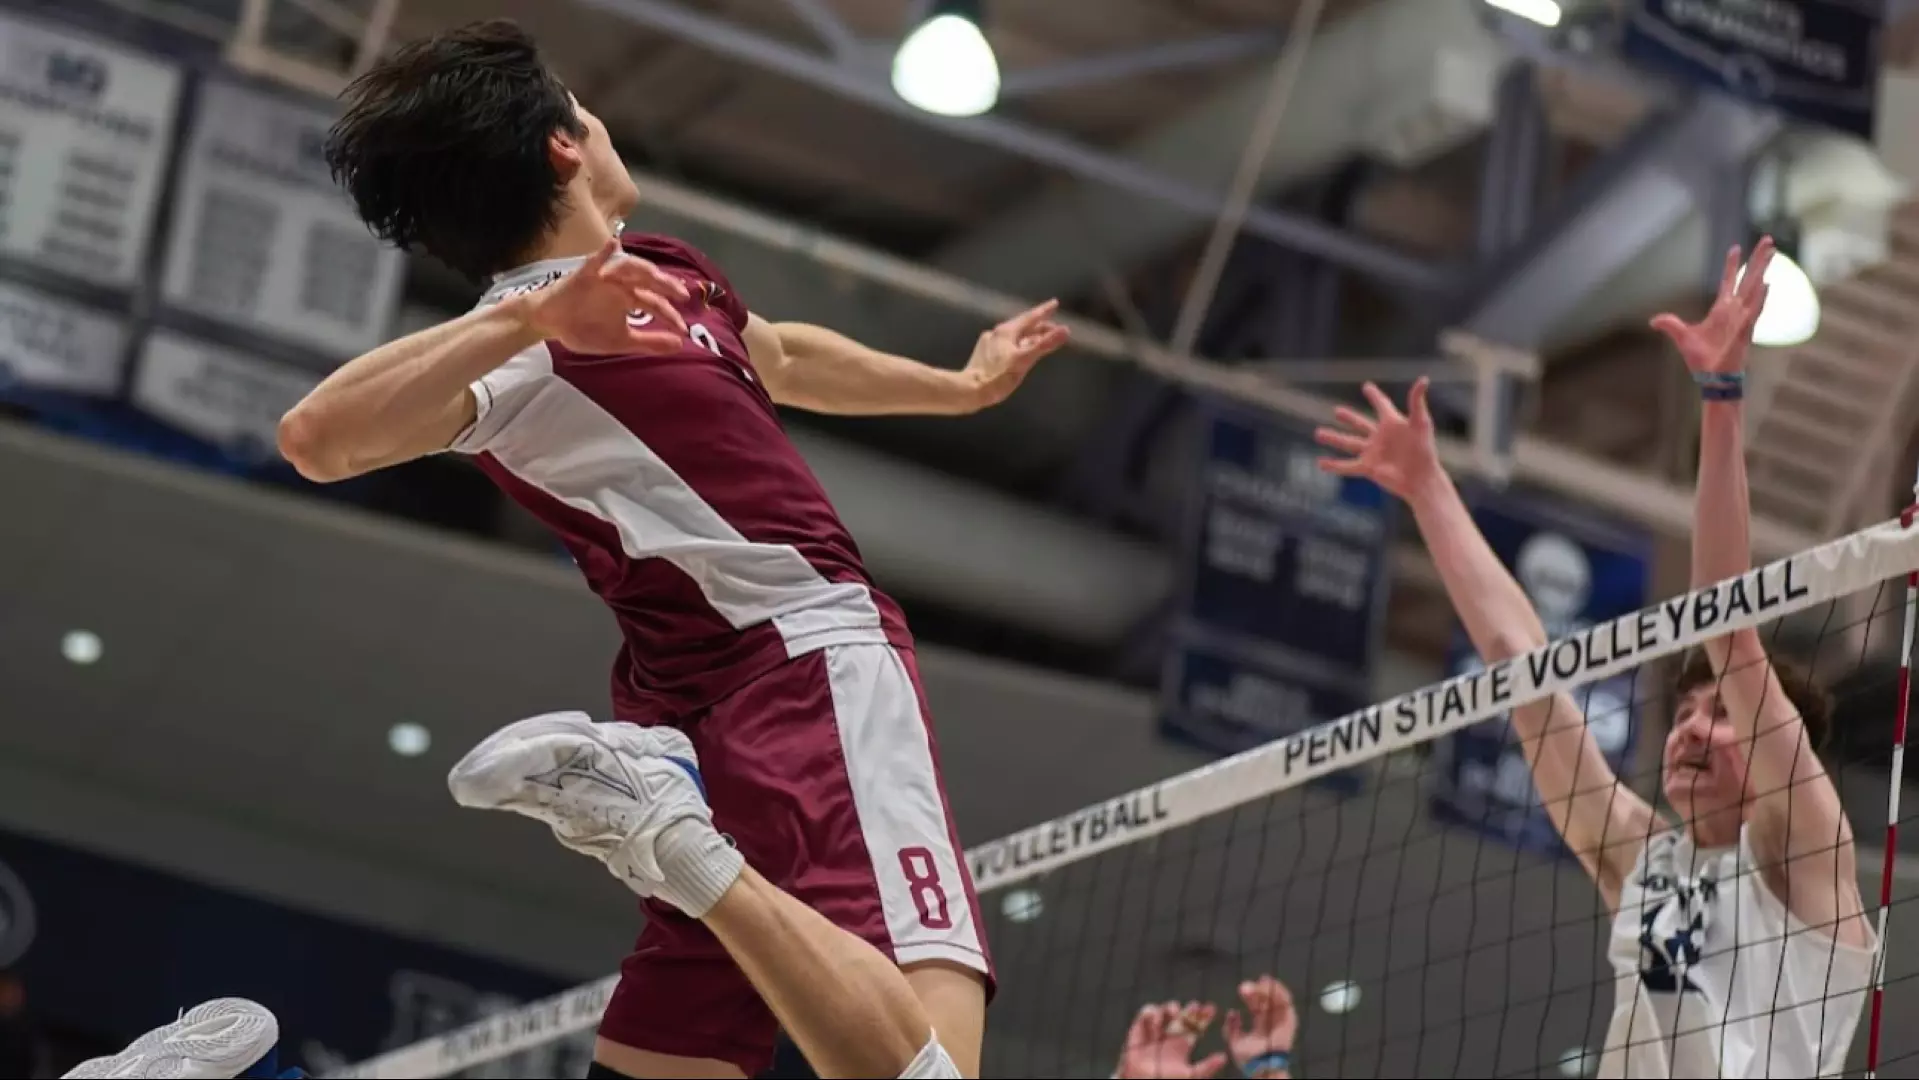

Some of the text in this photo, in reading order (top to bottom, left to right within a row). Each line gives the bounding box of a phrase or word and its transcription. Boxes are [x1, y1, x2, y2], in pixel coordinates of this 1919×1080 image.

[1284, 559, 1809, 775] PENN STATE VOLLEYBALL
[971, 785, 1168, 879] VOLLEYBALL
[897, 846, 953, 930] 8
